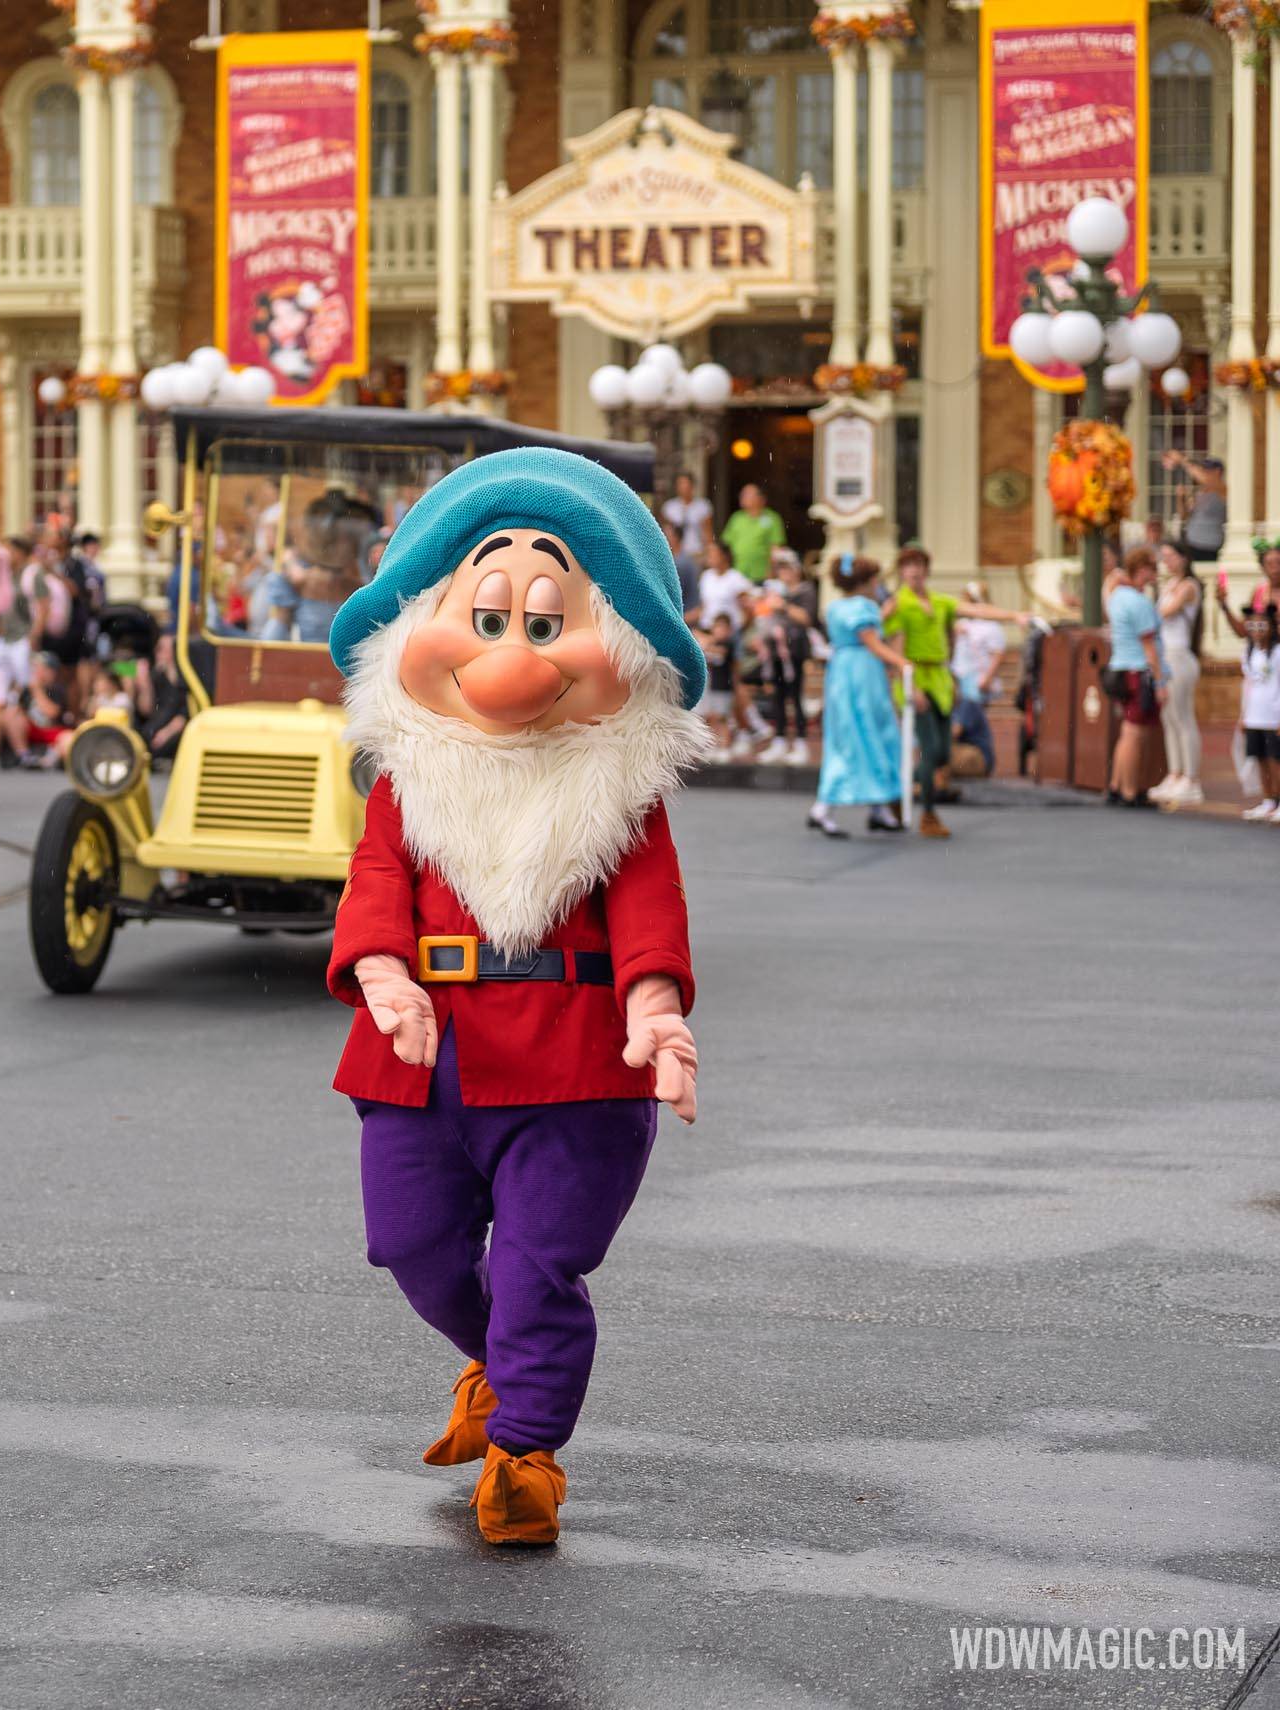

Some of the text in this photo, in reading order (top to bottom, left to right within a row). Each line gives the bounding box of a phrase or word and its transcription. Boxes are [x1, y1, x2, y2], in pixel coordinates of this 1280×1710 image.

[1031, 32, 1078, 51] SQUARE
[1080, 32, 1136, 56] THEATER
[994, 177, 1136, 235] MICKEY
[229, 208, 358, 258] MICKEY
[533, 223, 770, 274] THEATER
